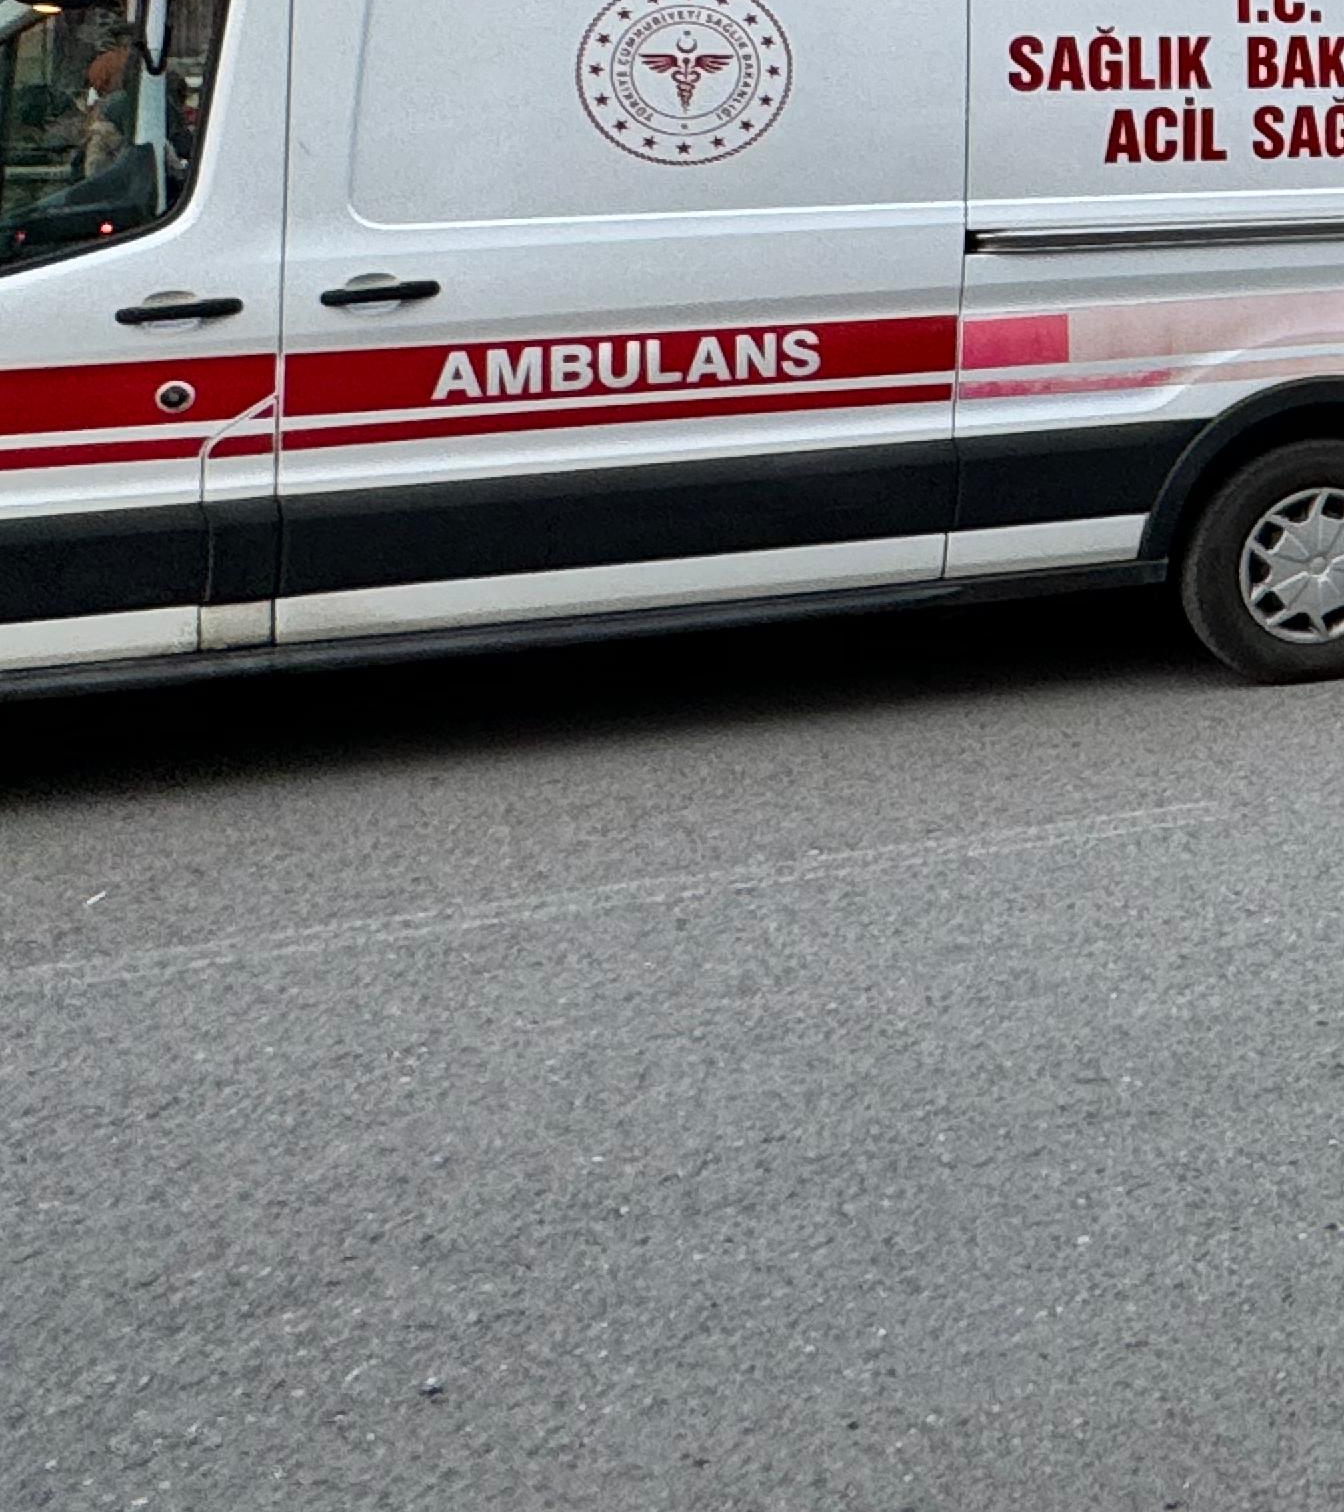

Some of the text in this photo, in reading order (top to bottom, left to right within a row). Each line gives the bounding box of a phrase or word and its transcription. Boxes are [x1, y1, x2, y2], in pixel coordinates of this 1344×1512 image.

[1008, 25, 1211, 92] SAĞLIK
[1104, 96, 1227, 163] ACİL
[431, 329, 823, 401] AMBULANS
